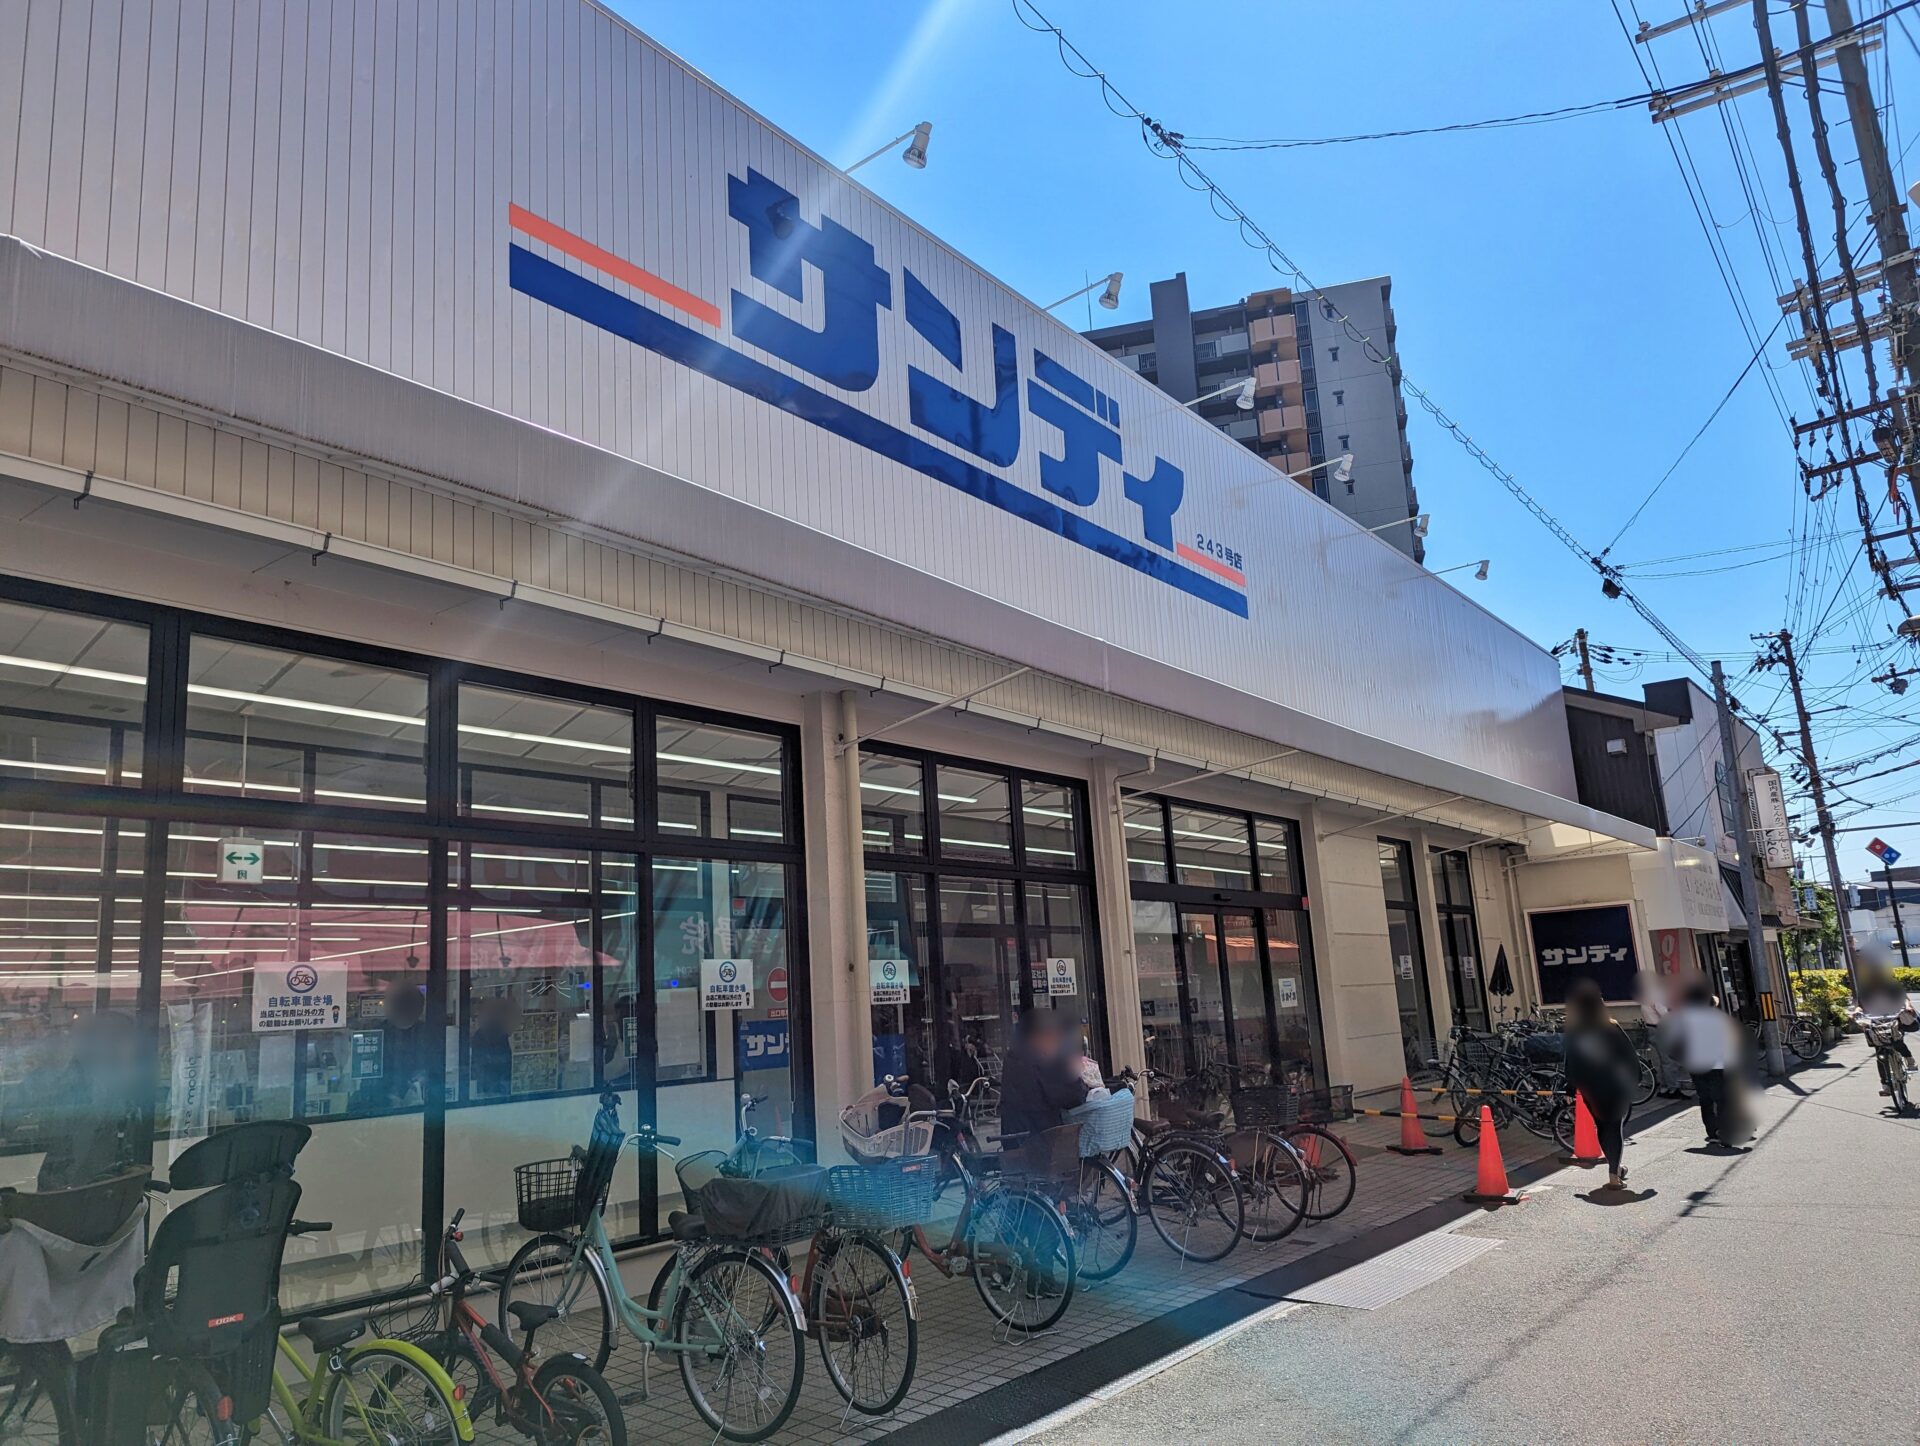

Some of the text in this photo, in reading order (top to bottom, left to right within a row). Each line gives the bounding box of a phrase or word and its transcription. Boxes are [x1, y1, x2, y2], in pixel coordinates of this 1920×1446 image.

[728, 166, 1184, 552] サンディ
[1196, 533, 1243, 571] 243号店
[1541, 944, 1628, 966] サンディ
[709, 984, 747, 993] 自転車置き場
[268, 995, 333, 1008] 自転車置き場
[259, 1008, 325, 1019] 当店ご利用以外の方
[258, 1018, 326, 1028] の駐輪はお断りします
[746, 1032, 789, 1057] サン
[215, 1315, 237, 1326] OGK
